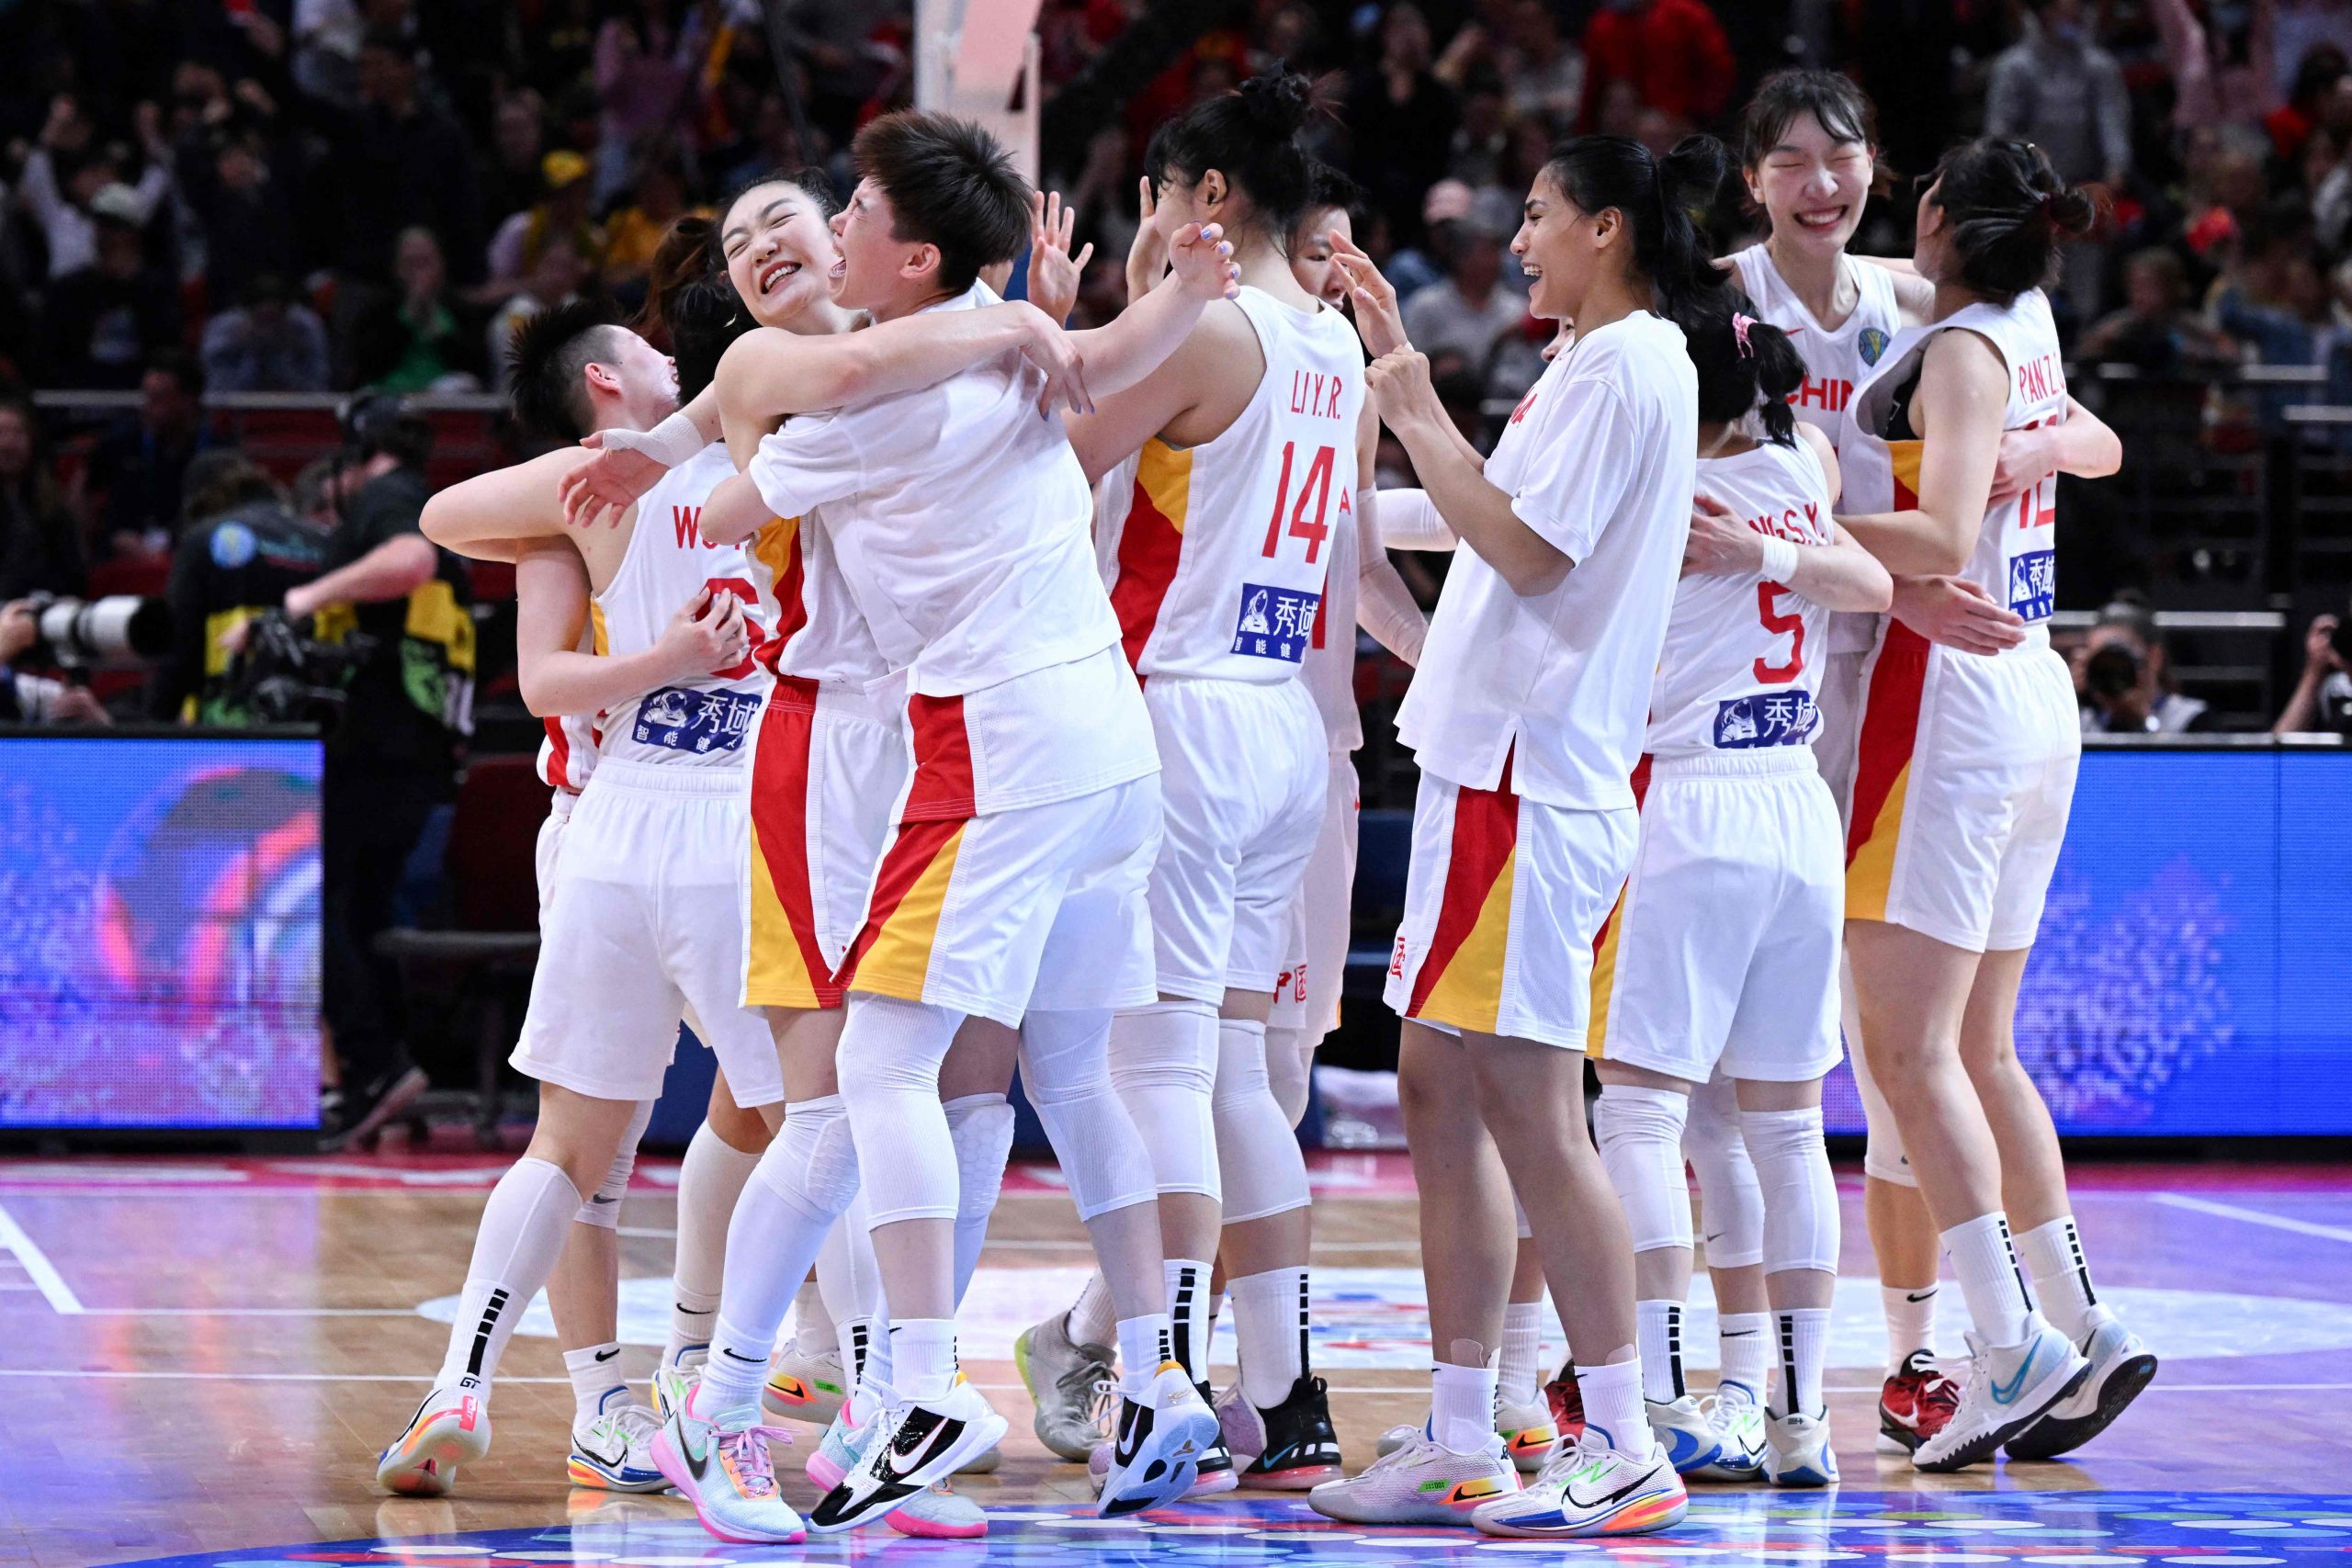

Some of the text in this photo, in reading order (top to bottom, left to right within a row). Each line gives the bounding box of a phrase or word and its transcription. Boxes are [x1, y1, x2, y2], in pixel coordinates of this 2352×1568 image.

[1261, 441, 1336, 564] 14
[1752, 580, 1804, 684] 5
[691, 694, 760, 735] 秀域
